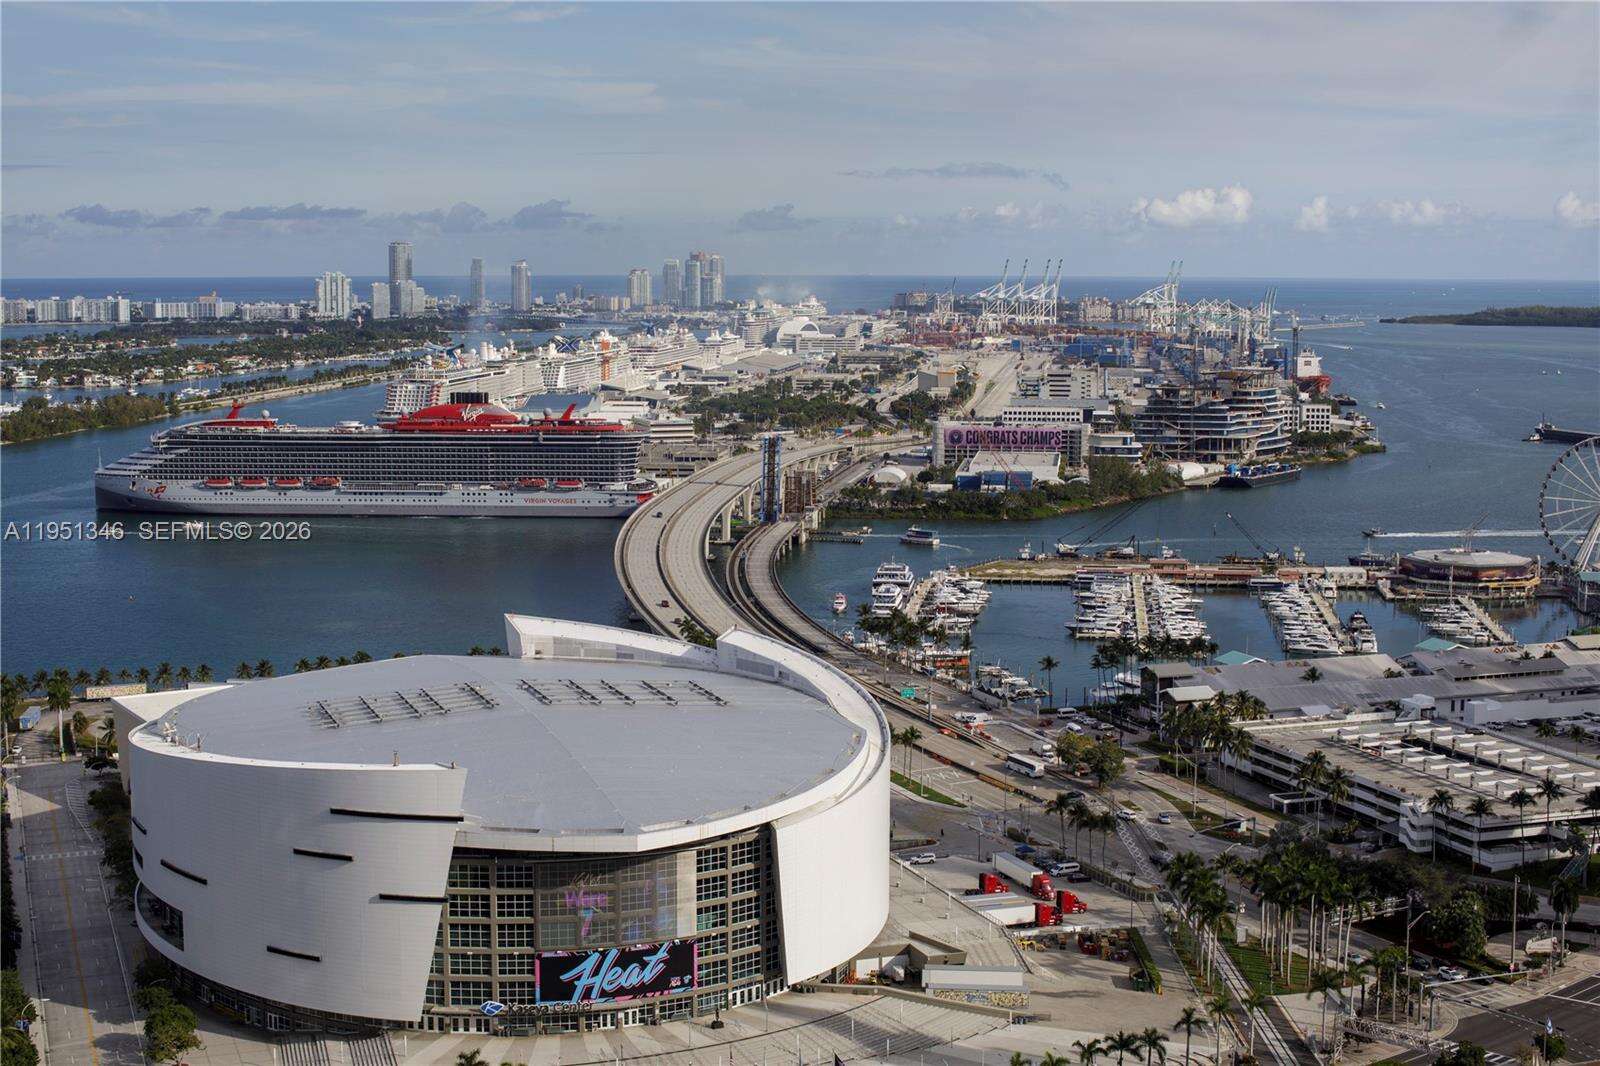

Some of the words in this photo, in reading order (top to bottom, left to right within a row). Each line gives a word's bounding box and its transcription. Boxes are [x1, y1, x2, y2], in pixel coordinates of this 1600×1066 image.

[461, 404, 485, 421] Virgin
[966, 430, 1018, 445] CONGRATS
[1020, 430, 1061, 446] CHAMPS
[560, 940, 671, 1004] Heat
[507, 1001, 550, 1015] Kaseya
[553, 1000, 593, 1013] Center
